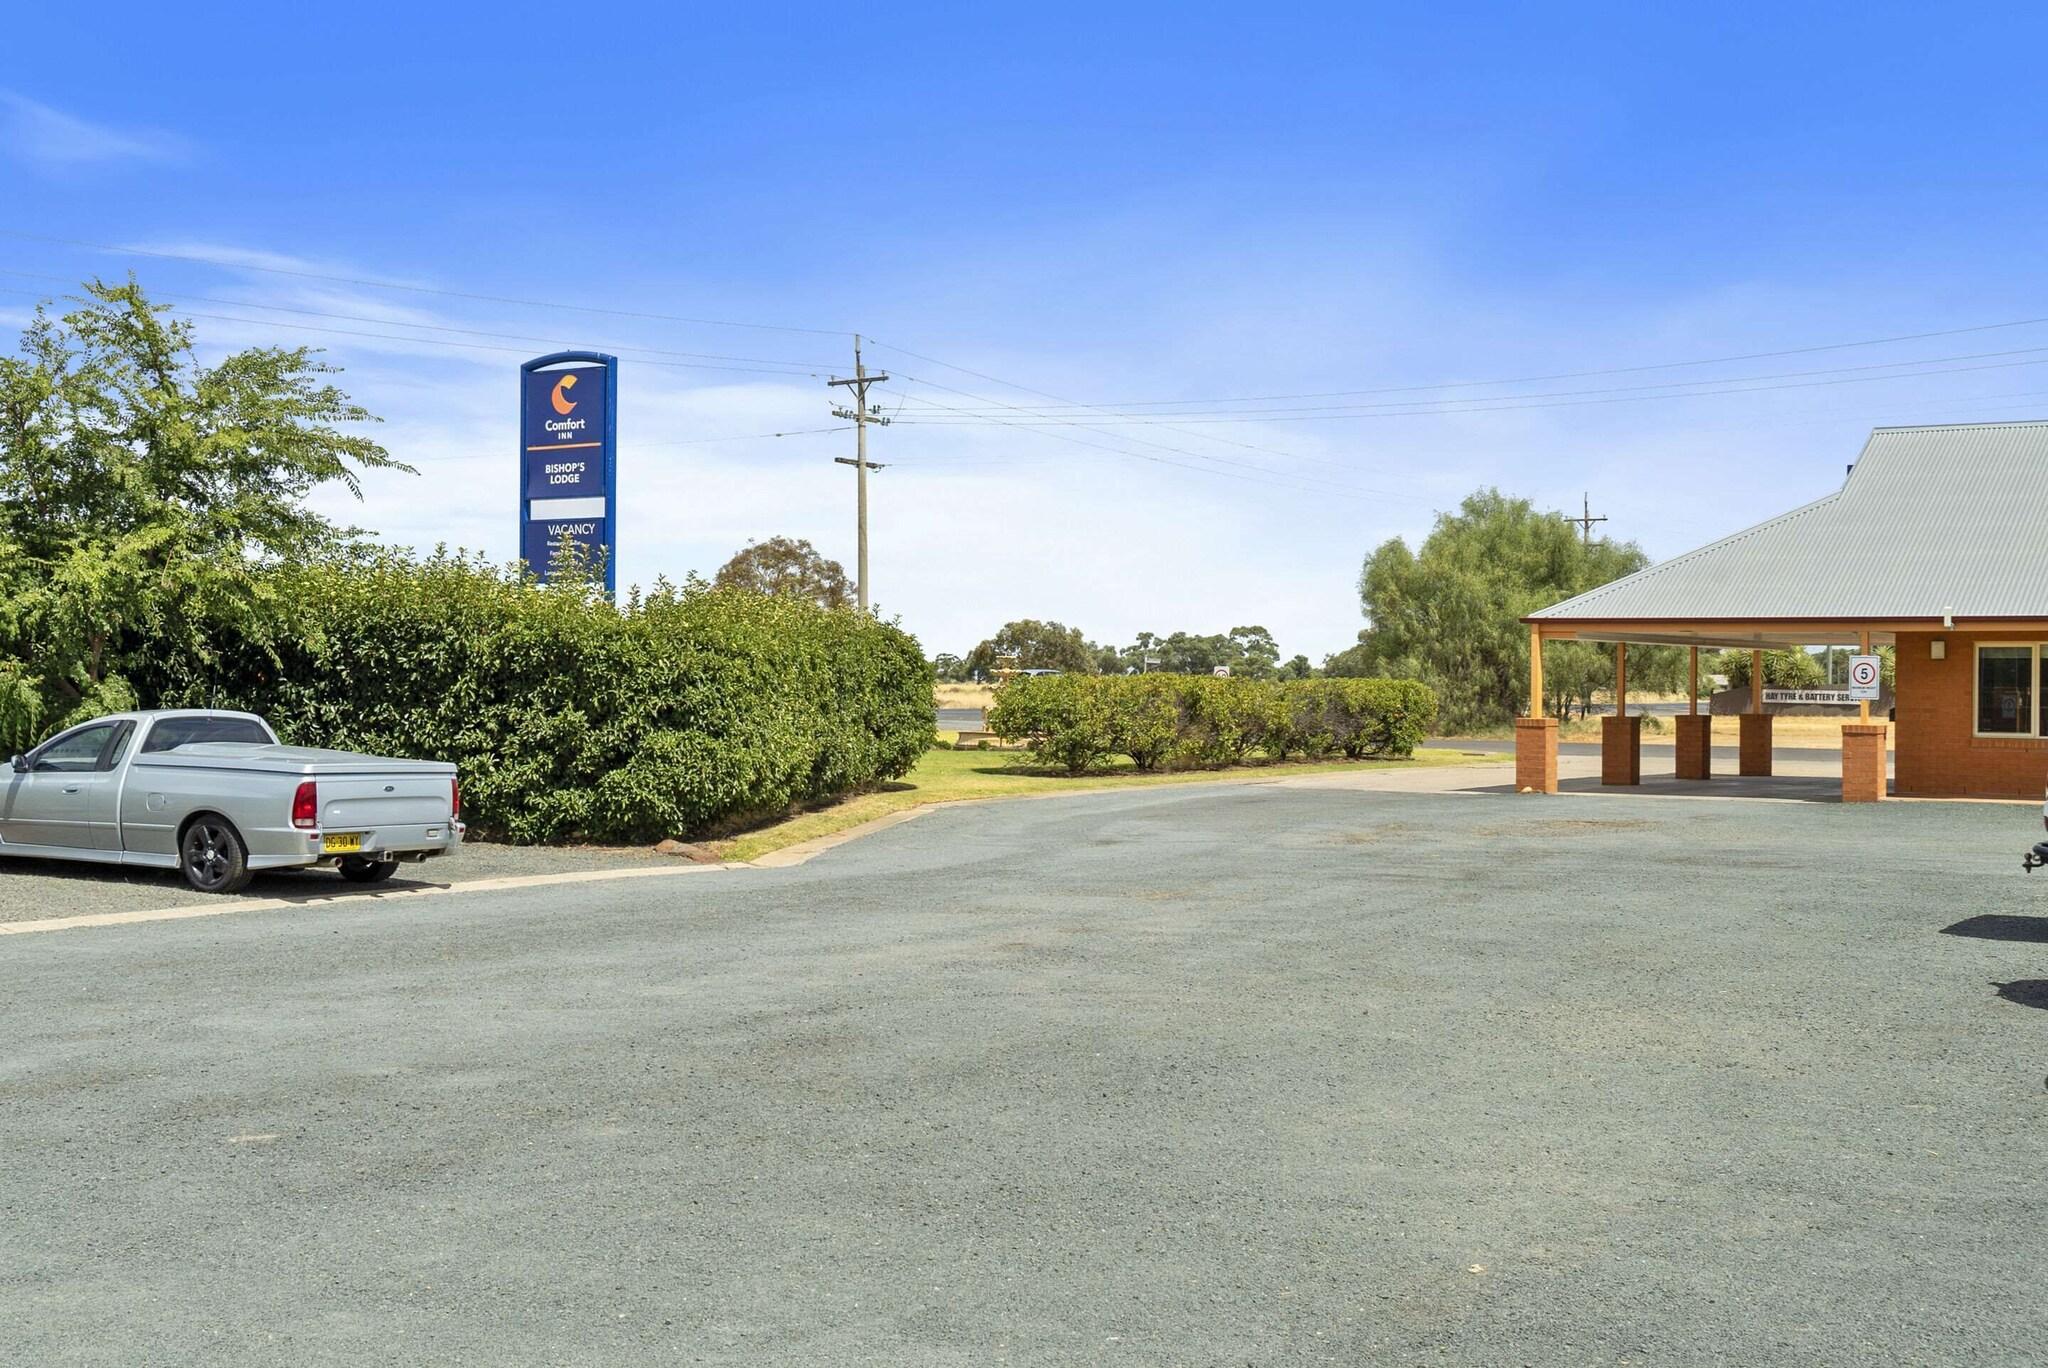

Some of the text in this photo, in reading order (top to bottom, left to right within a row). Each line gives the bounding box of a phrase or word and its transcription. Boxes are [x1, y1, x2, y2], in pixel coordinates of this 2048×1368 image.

[545, 418, 586, 431] Comfort
[558, 431, 573, 440] INN
[545, 462, 585, 473] BISHOP'S
[550, 474, 580, 484] LODGE
[548, 523, 596, 535] VACANCY
[1860, 668, 1868, 680] 5
[1765, 692, 1778, 700] HAY
[1780, 692, 1797, 700] TYRE
[1805, 693, 1835, 701] BATTERY
